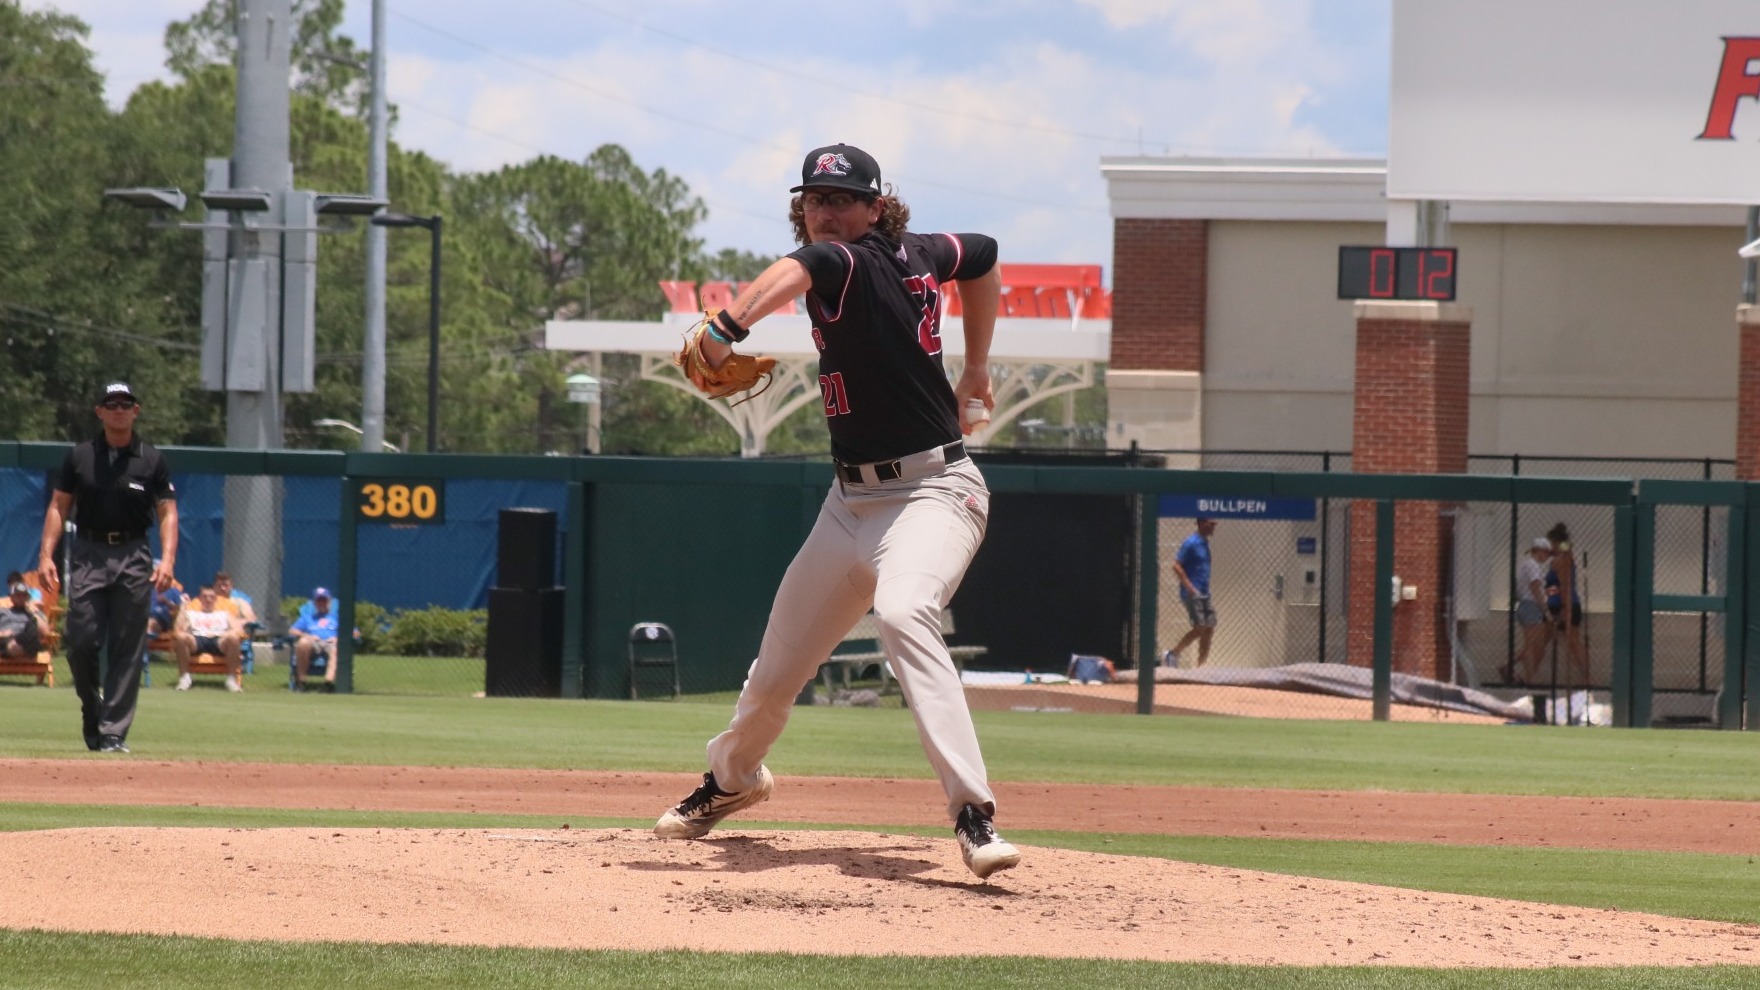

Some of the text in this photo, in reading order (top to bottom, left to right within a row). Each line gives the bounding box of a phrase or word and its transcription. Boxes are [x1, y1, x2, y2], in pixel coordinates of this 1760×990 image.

[1417, 250, 1453, 298] 12
[819, 371, 851, 417] 21
[361, 483, 437, 519] 380
[1198, 499, 1267, 513] BULLPEN
